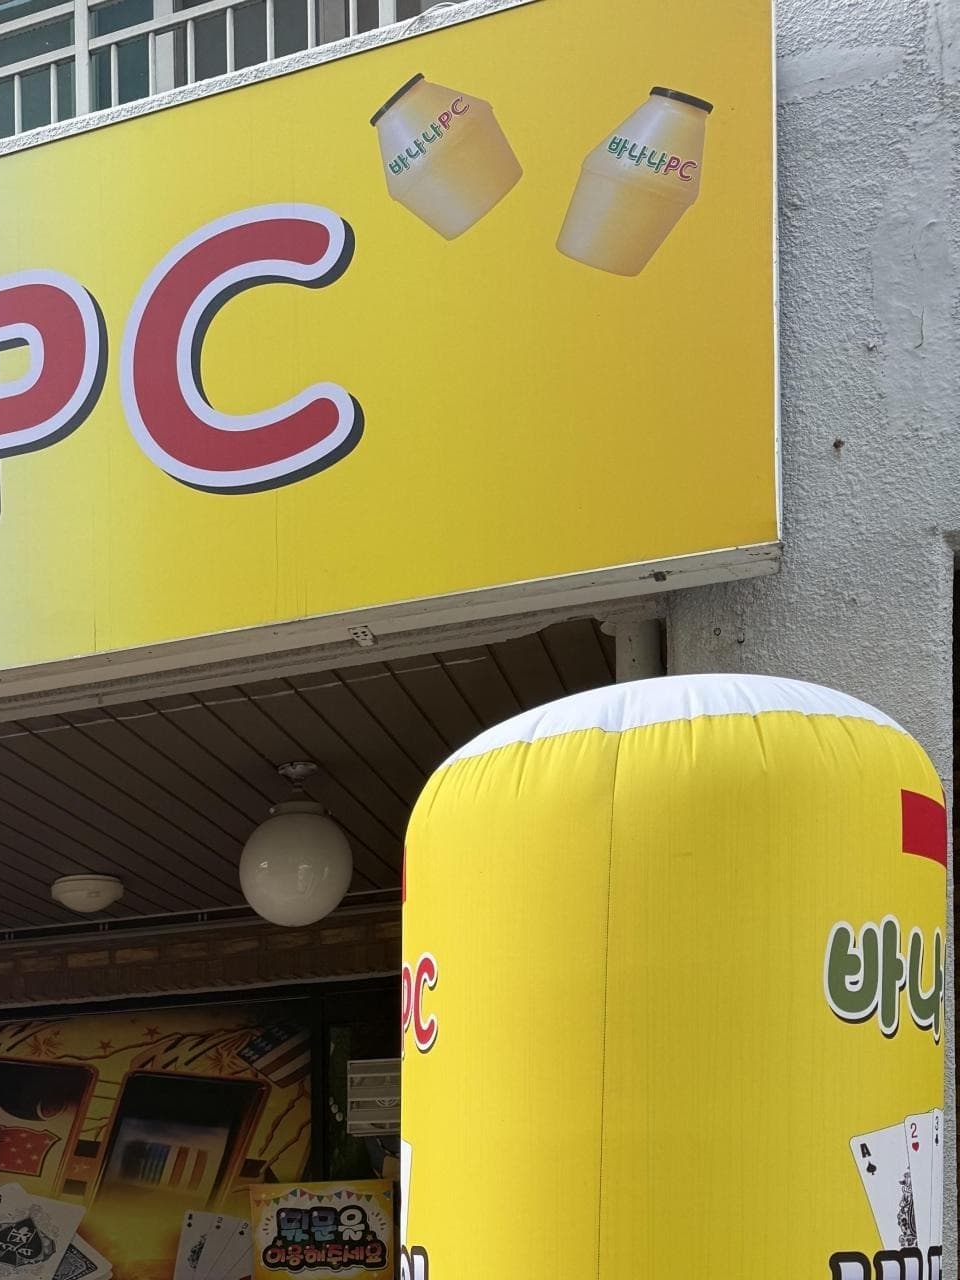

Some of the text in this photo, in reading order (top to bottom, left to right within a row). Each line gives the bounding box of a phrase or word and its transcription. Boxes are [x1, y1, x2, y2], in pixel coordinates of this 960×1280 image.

[389, 97, 471, 177] 바나나PC
[607, 135, 698, 183] 바나나PC
[859, 1143, 872, 1159] A
[263, 1242, 386, 1271] 이용해주세요
